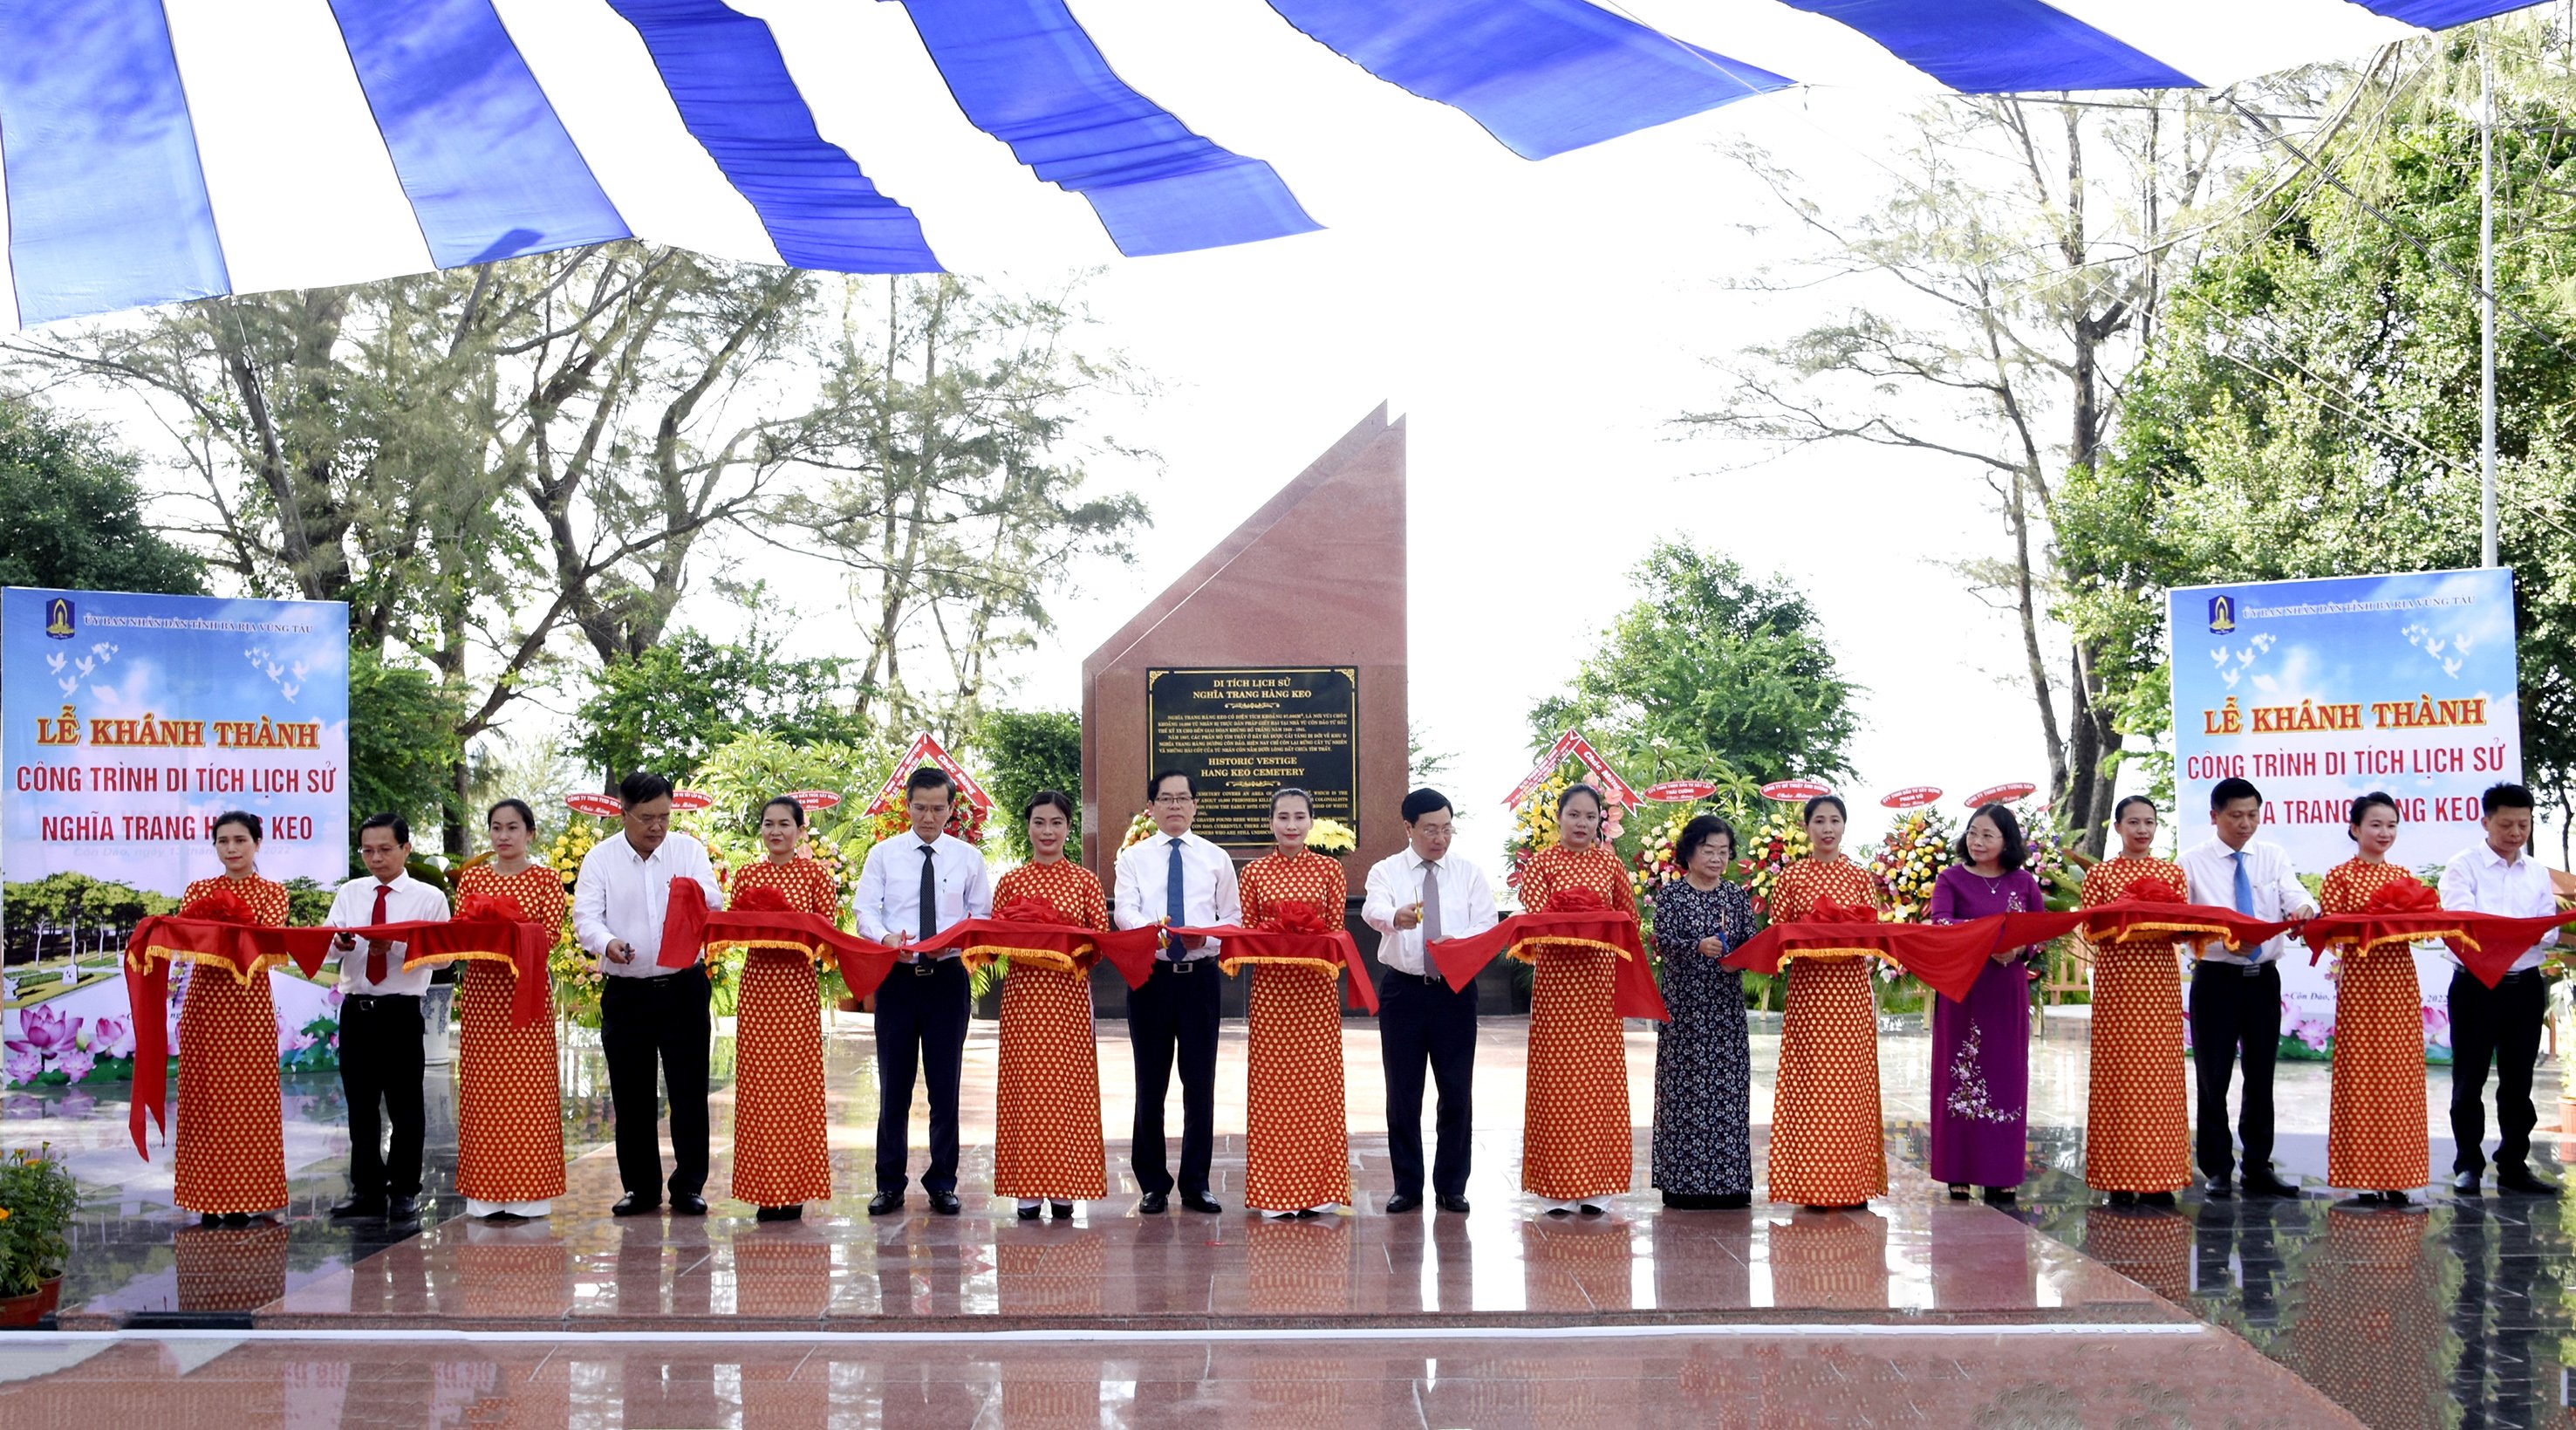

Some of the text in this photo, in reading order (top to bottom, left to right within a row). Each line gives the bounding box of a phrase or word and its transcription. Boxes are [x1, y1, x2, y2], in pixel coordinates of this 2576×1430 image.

[104, 617, 126, 626] BAN
[130, 615, 161, 627] NHÂN
[165, 616, 188, 628] DÂN
[2261, 607, 2282, 618] BAN
[1226, 678, 1249, 688] TÍCH
[1252, 679, 1275, 688] LỊCH
[1277, 676, 1291, 688] SỬ
[1192, 689, 1224, 699] NGHĨA
[1261, 688, 1289, 698] HÀNG
[2204, 694, 2486, 736] LỄ KHÁNH THÀNH
[36, 704, 320, 749] LỄ KHÁNH THÀNH
[937, 754, 957, 774] Chúc
[1208, 756, 1298, 766] HISTORIC VESTIGE
[1583, 751, 1602, 771] Chúc
[2187, 736, 2506, 779] CÔNG TRÌNH DI TÍCH LỊCH SỬ
[17, 760, 337, 798] CÔNG TRÌNH DI TÍCH LỊCH SỬ
[1253, 768, 1305, 777] CEMETERY
[2395, 797, 2426, 822] NG
[2435, 797, 2479, 823] KEO
[41, 811, 115, 841] NGHĨA
[121, 816, 195, 841] TRANG
[271, 816, 313, 840] KEO
